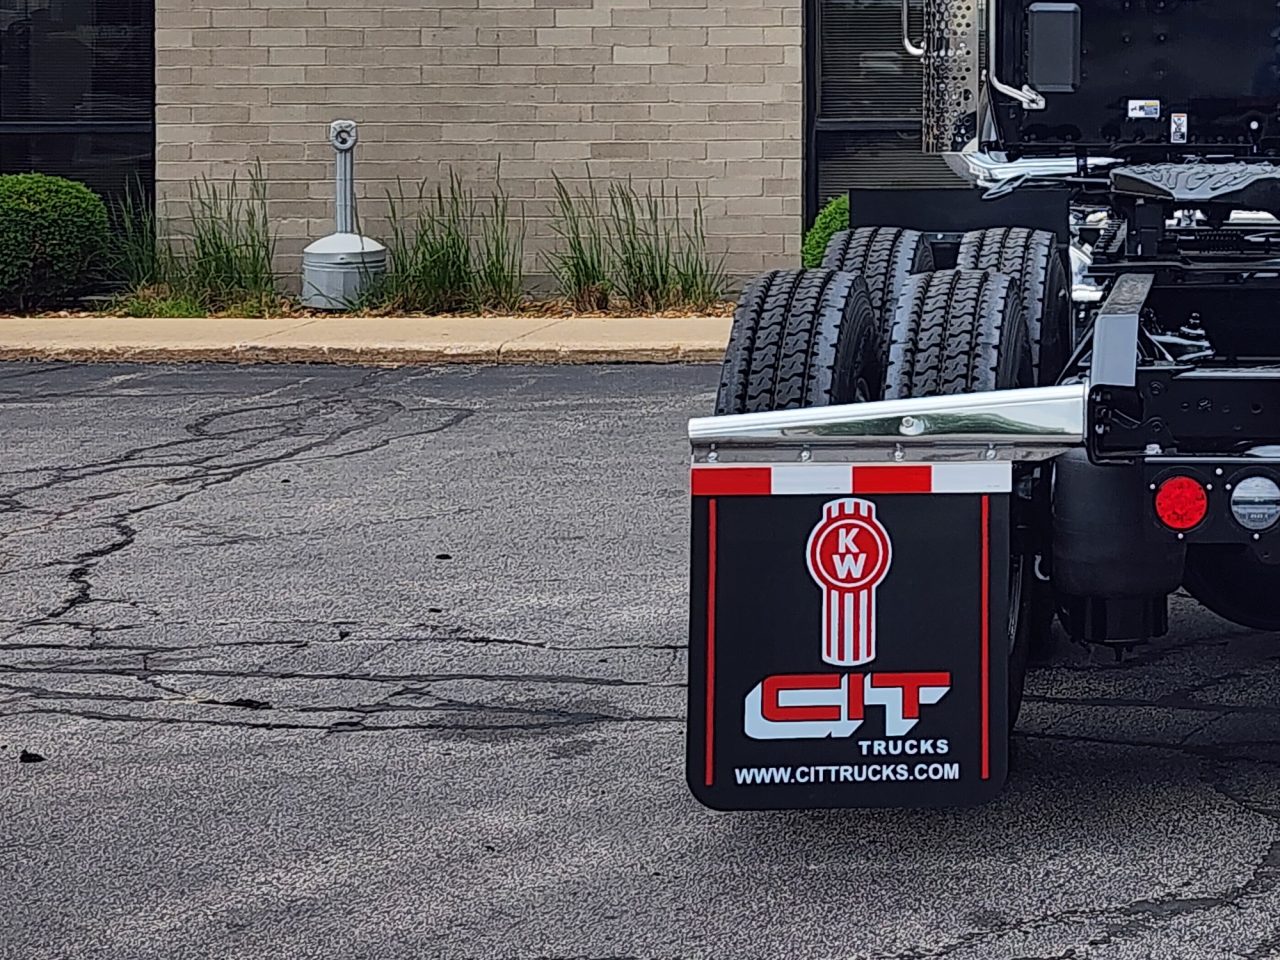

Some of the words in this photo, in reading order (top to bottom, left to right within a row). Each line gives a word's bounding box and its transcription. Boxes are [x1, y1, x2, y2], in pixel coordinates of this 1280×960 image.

[745, 671, 951, 740] CIT
[858, 738, 949, 756] TRUCKS
[734, 762, 960, 785] WWW.CITTRUCKS.COM
